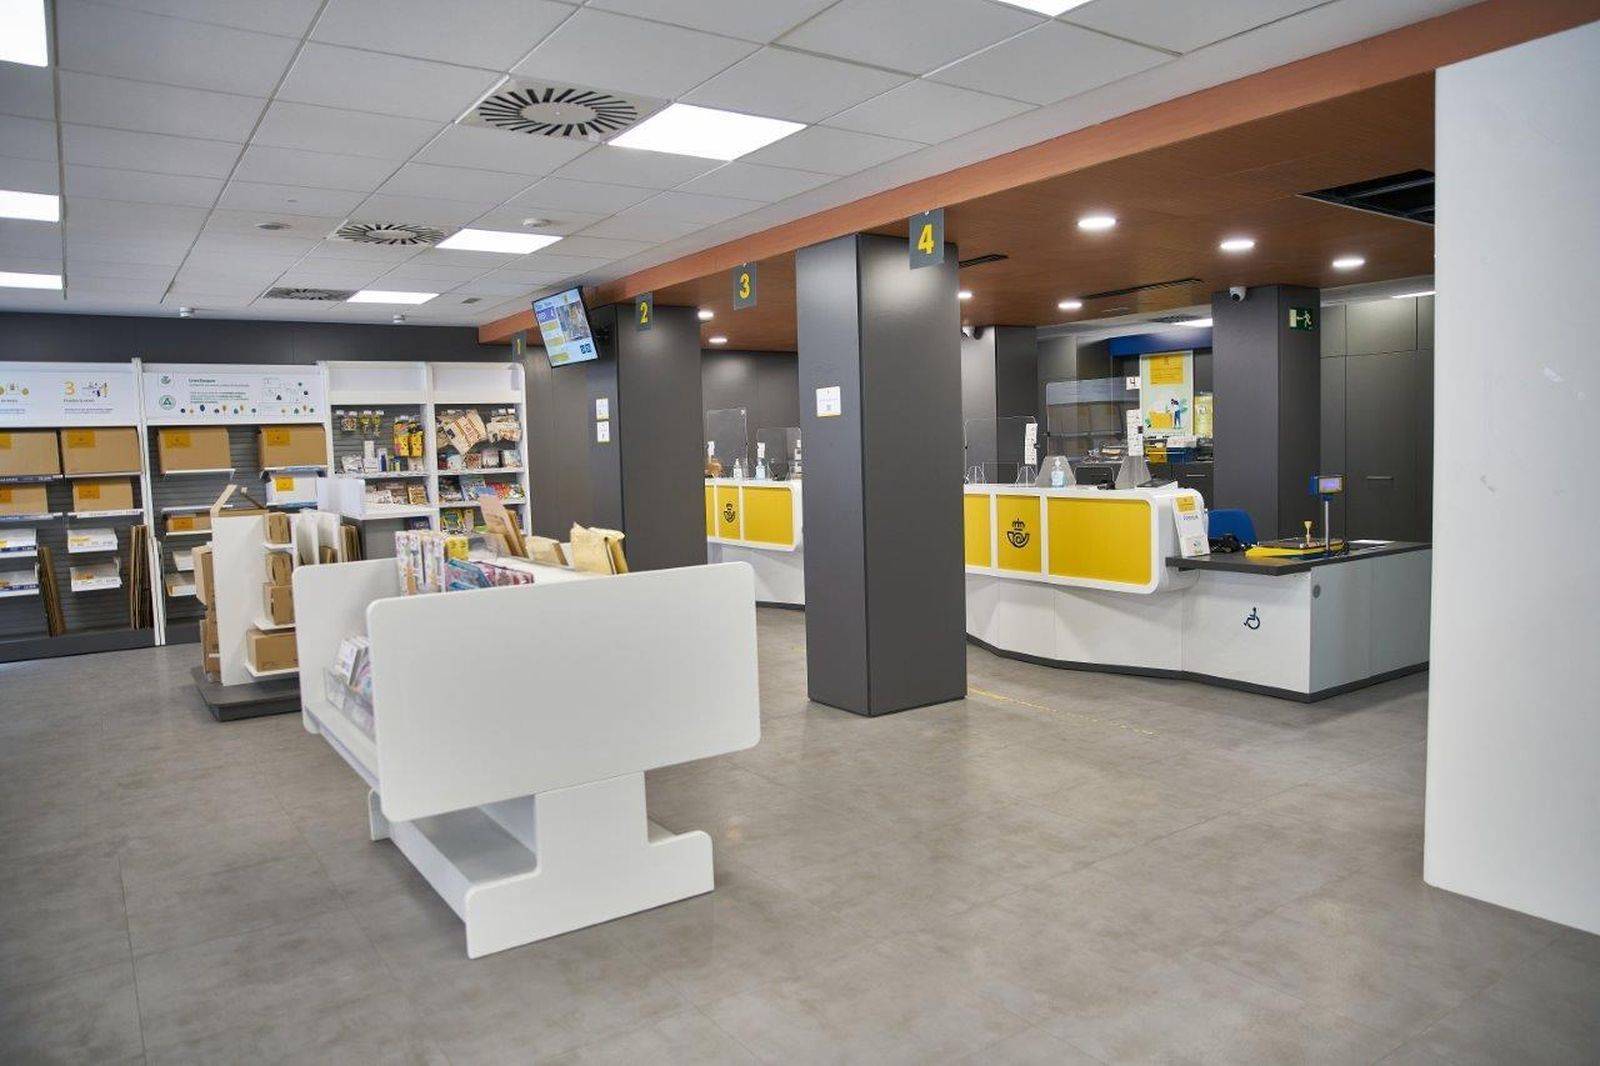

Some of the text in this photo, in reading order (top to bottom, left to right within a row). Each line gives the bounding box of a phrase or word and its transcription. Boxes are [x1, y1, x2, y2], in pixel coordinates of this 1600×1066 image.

[918, 224, 934, 254] 4
[740, 273, 750, 299] 3
[640, 302, 648, 324] 2
[64, 381, 75, 396] 3
[1129, 377, 1136, 388] 4
